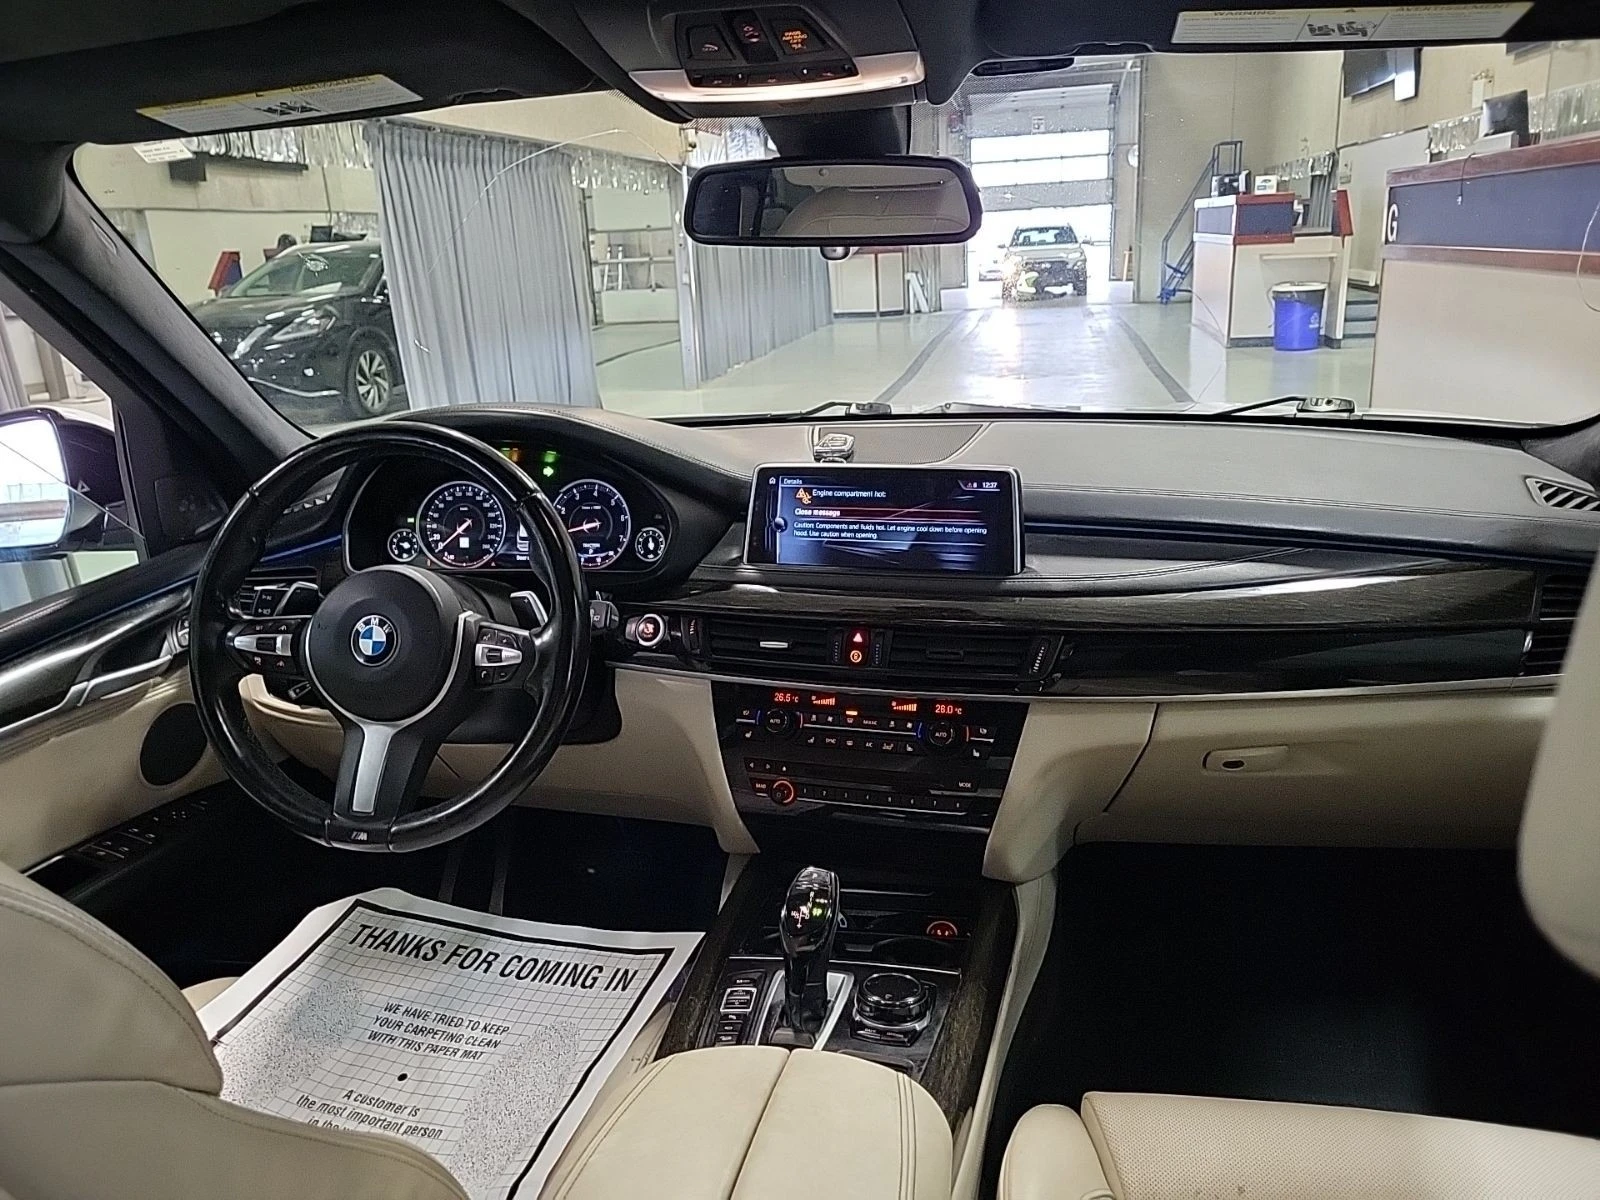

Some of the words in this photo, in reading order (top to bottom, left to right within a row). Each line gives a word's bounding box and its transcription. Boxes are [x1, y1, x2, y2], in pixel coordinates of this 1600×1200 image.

[1387, 203, 1398, 242] G
[812, 489, 833, 498] Engine
[833, 490, 873, 498] compartment
[794, 508, 812, 516] Close
[812, 508, 841, 518] message
[815, 523, 848, 531] Components
[896, 525, 916, 533] engine
[963, 527, 987, 535] opening
[356, 617, 393, 634] BMW
[774, 692, 791, 702] 26.5
[348, 923, 447, 962] THANKS
[442, 944, 501, 975] FOR
[499, 954, 604, 990] COMING
[603, 967, 639, 992] IN
[372, 1015, 404, 1032] YOUR
[403, 1022, 466, 1044] CARPETING
[464, 1035, 502, 1049] CLEAN
[383, 1002, 403, 1015] WE
[401, 1006, 432, 1021] HAVE
[431, 1012, 465, 1029] TRIED
[465, 1019, 481, 1032] TO
[480, 1022, 510, 1036] KEEP
[367, 1030, 399, 1045] WITH
[397, 1036, 423, 1052] THIS
[422, 1043, 461, 1059] PAPER
[459, 1049, 486, 1060] MAT
[296, 1094, 317, 1109] the
[316, 1102, 349, 1117] most
[347, 1107, 405, 1134] important
[402, 1126, 443, 1139] person
[342, 1089, 355, 1100] A
[353, 1093, 408, 1118] customer
[407, 1105, 421, 1118] is
[307, 1116, 319, 1127] in
[321, 1119, 340, 1130] the
